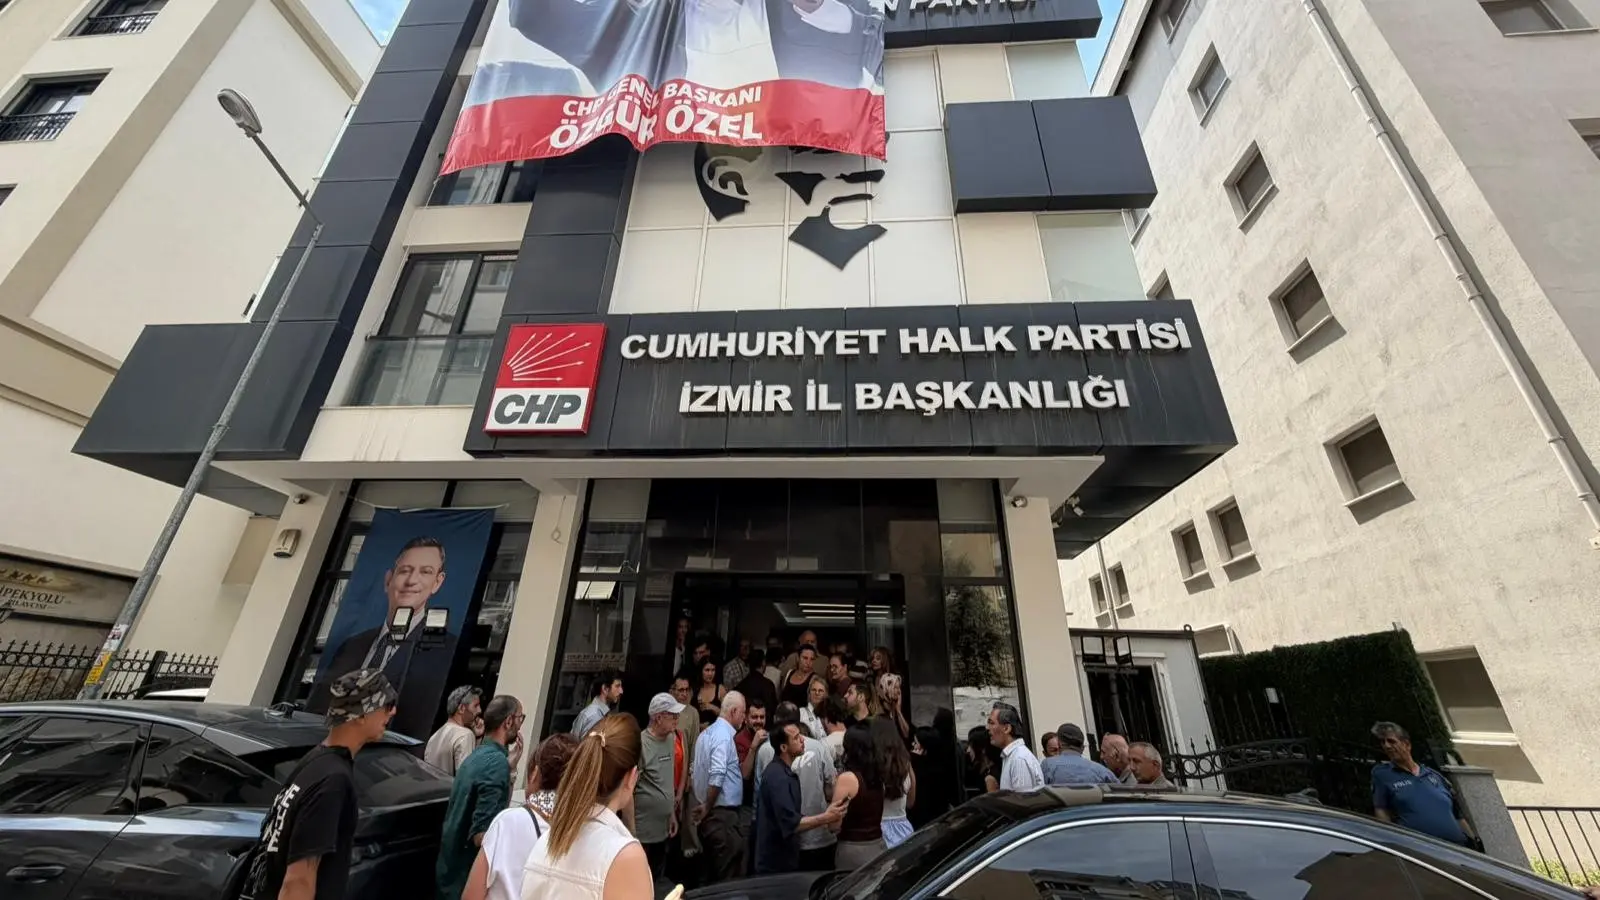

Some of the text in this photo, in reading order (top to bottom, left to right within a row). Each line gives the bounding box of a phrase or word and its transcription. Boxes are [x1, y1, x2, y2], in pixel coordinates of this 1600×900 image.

[563, 97, 605, 117] CHP
[663, 83, 762, 108] BAŞKANI
[549, 94, 763, 148] ÖZGÜR ÖZEL
[620, 318, 1192, 357] CUMHURİYET HALK PARTİSİ
[494, 393, 582, 425] CHP
[679, 374, 1130, 416] İZMİR İL BAŞKANLIĞI
